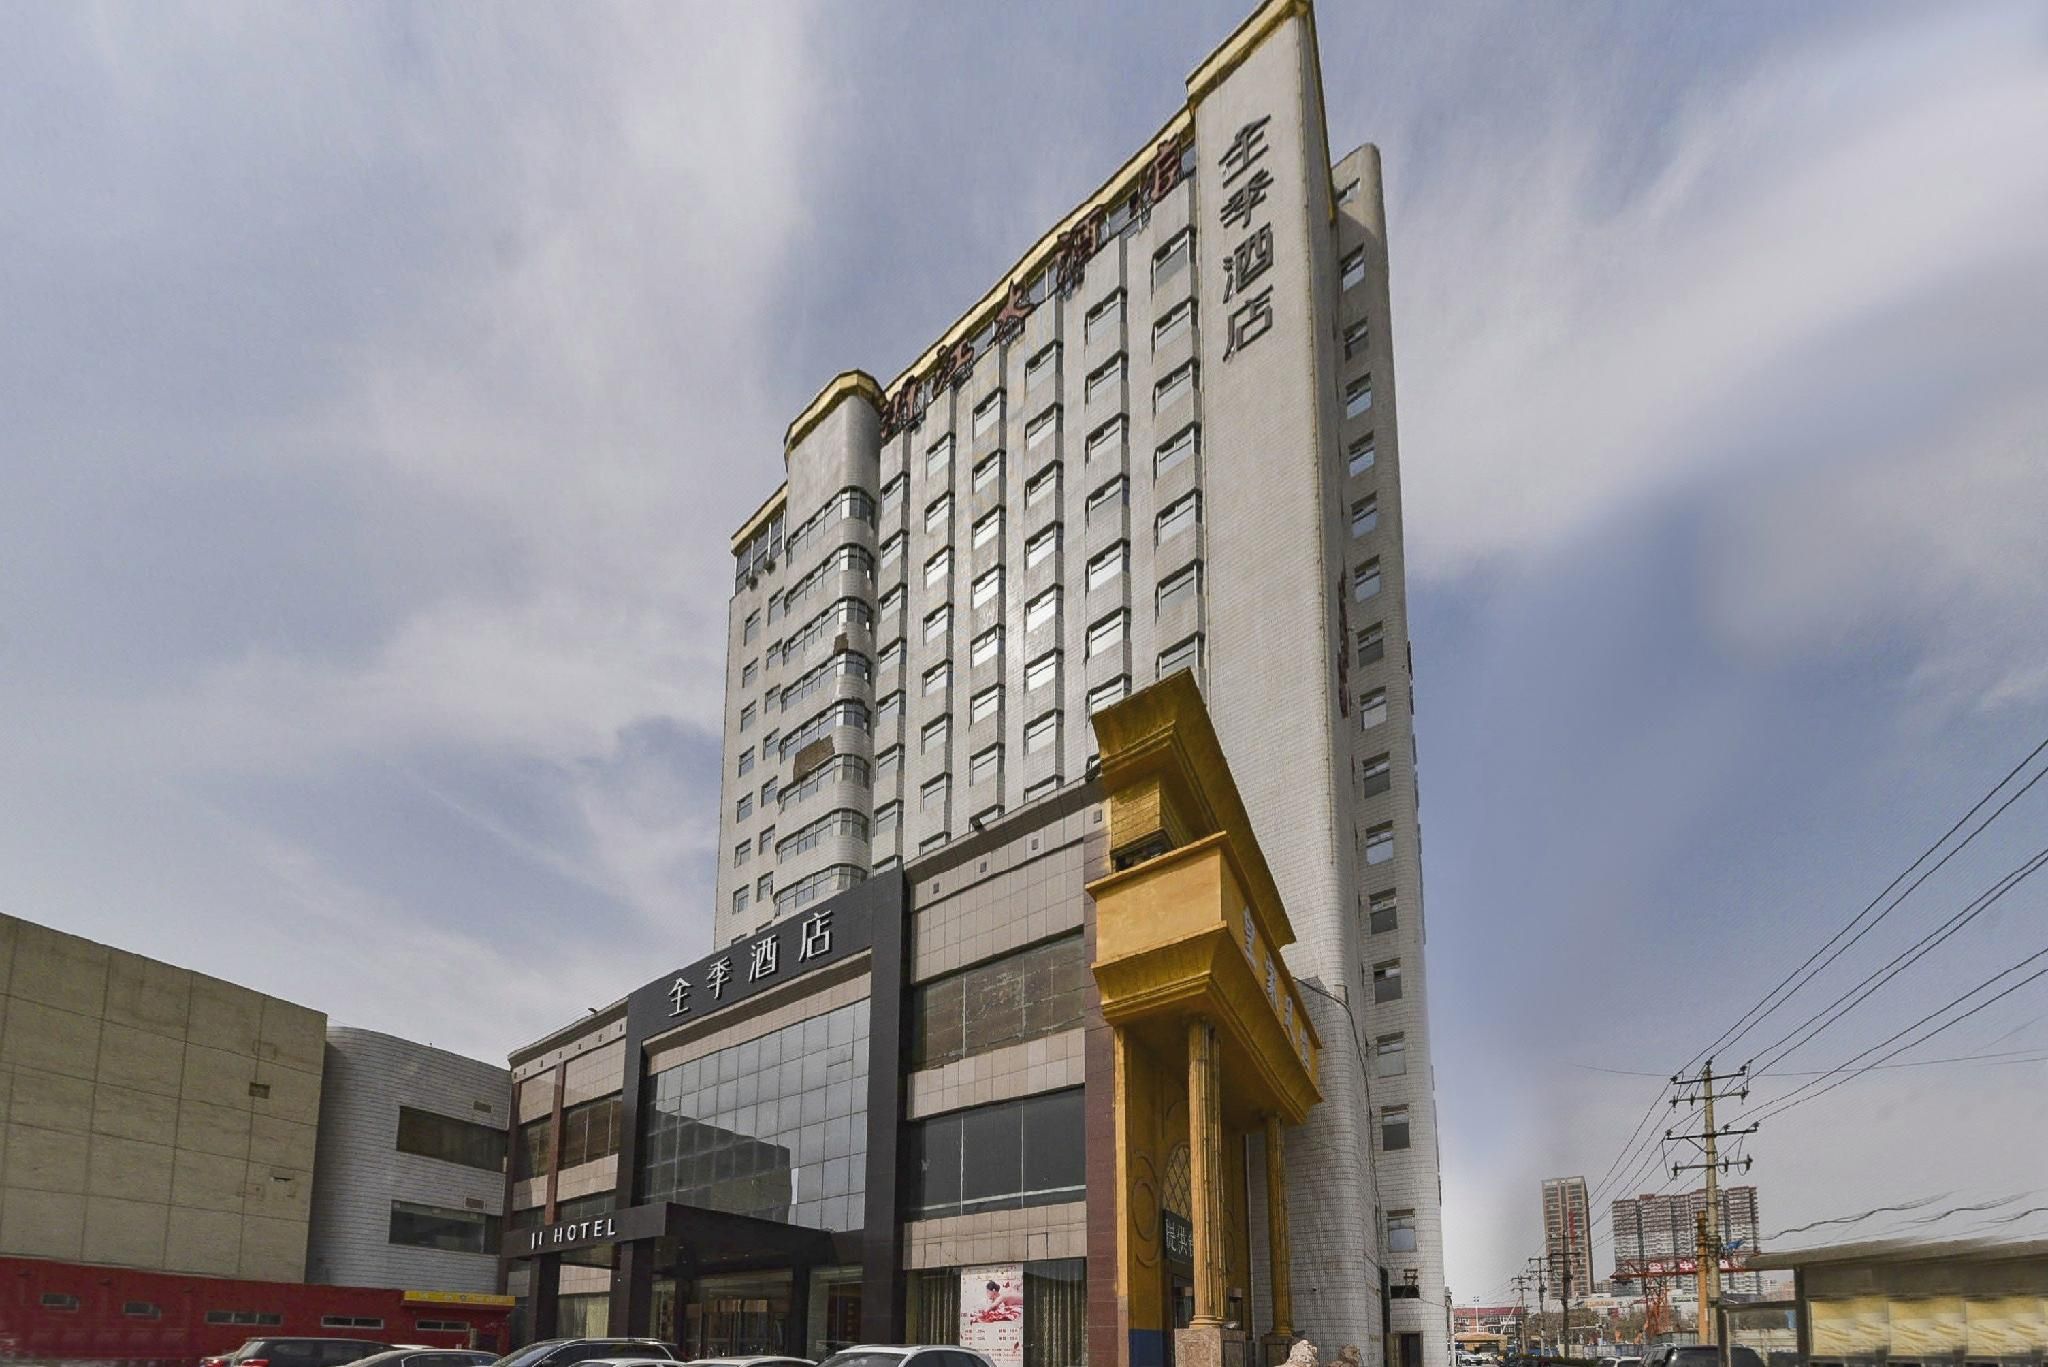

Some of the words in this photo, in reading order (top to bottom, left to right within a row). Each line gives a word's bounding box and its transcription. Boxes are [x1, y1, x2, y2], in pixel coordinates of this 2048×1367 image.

[1218, 113, 1275, 362] 全季酒店
[666, 910, 834, 1017] 全季酒店
[553, 1218, 616, 1243] HOTEL
